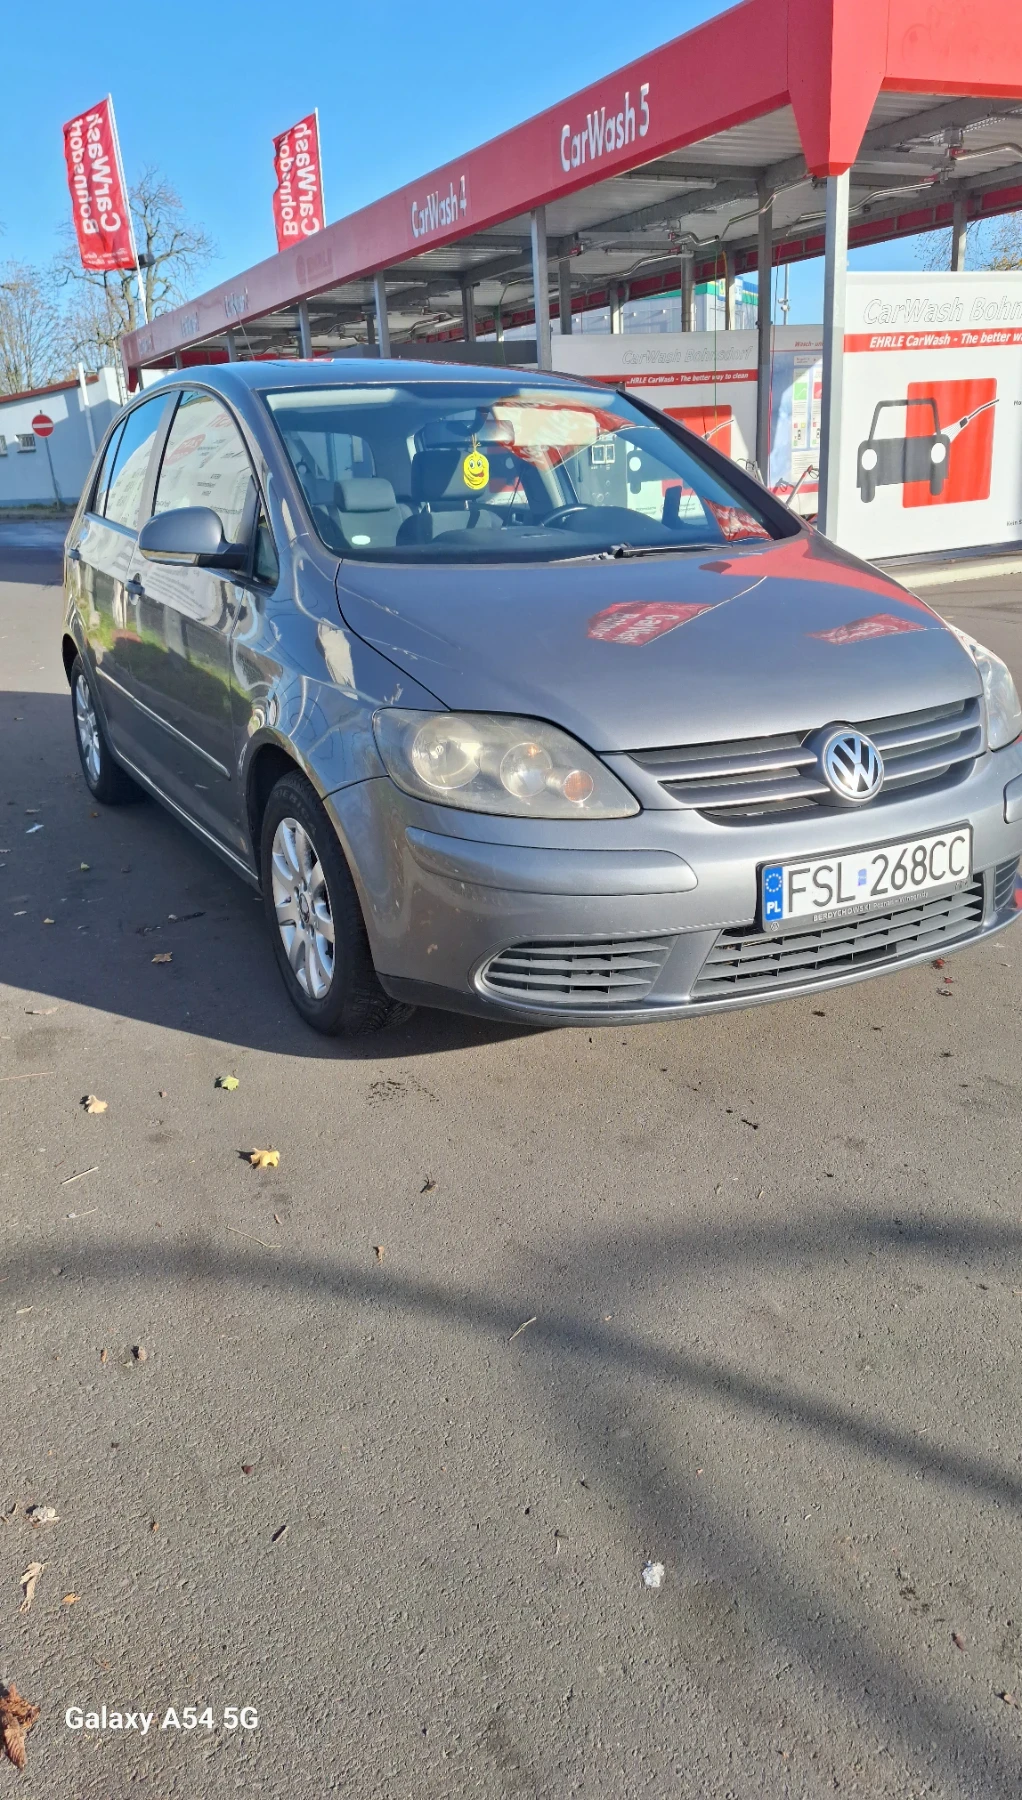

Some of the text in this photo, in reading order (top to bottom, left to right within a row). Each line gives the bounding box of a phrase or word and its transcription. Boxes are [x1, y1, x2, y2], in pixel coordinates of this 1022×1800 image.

[560, 82, 650, 172] CarWash 5
[411, 182, 459, 239] CarWash
[862, 297, 965, 325] CarWash
[869, 335, 906, 349] EHRLE
[905, 334, 952, 347] CarWash
[960, 332, 979, 344] The
[979, 331, 1011, 343] better
[621, 349, 682, 365] CarWash
[647, 375, 675, 384] CarWash
[680, 374, 692, 382] The
[787, 835, 966, 913] FSL 268CC
[766, 900, 782, 915] PL
